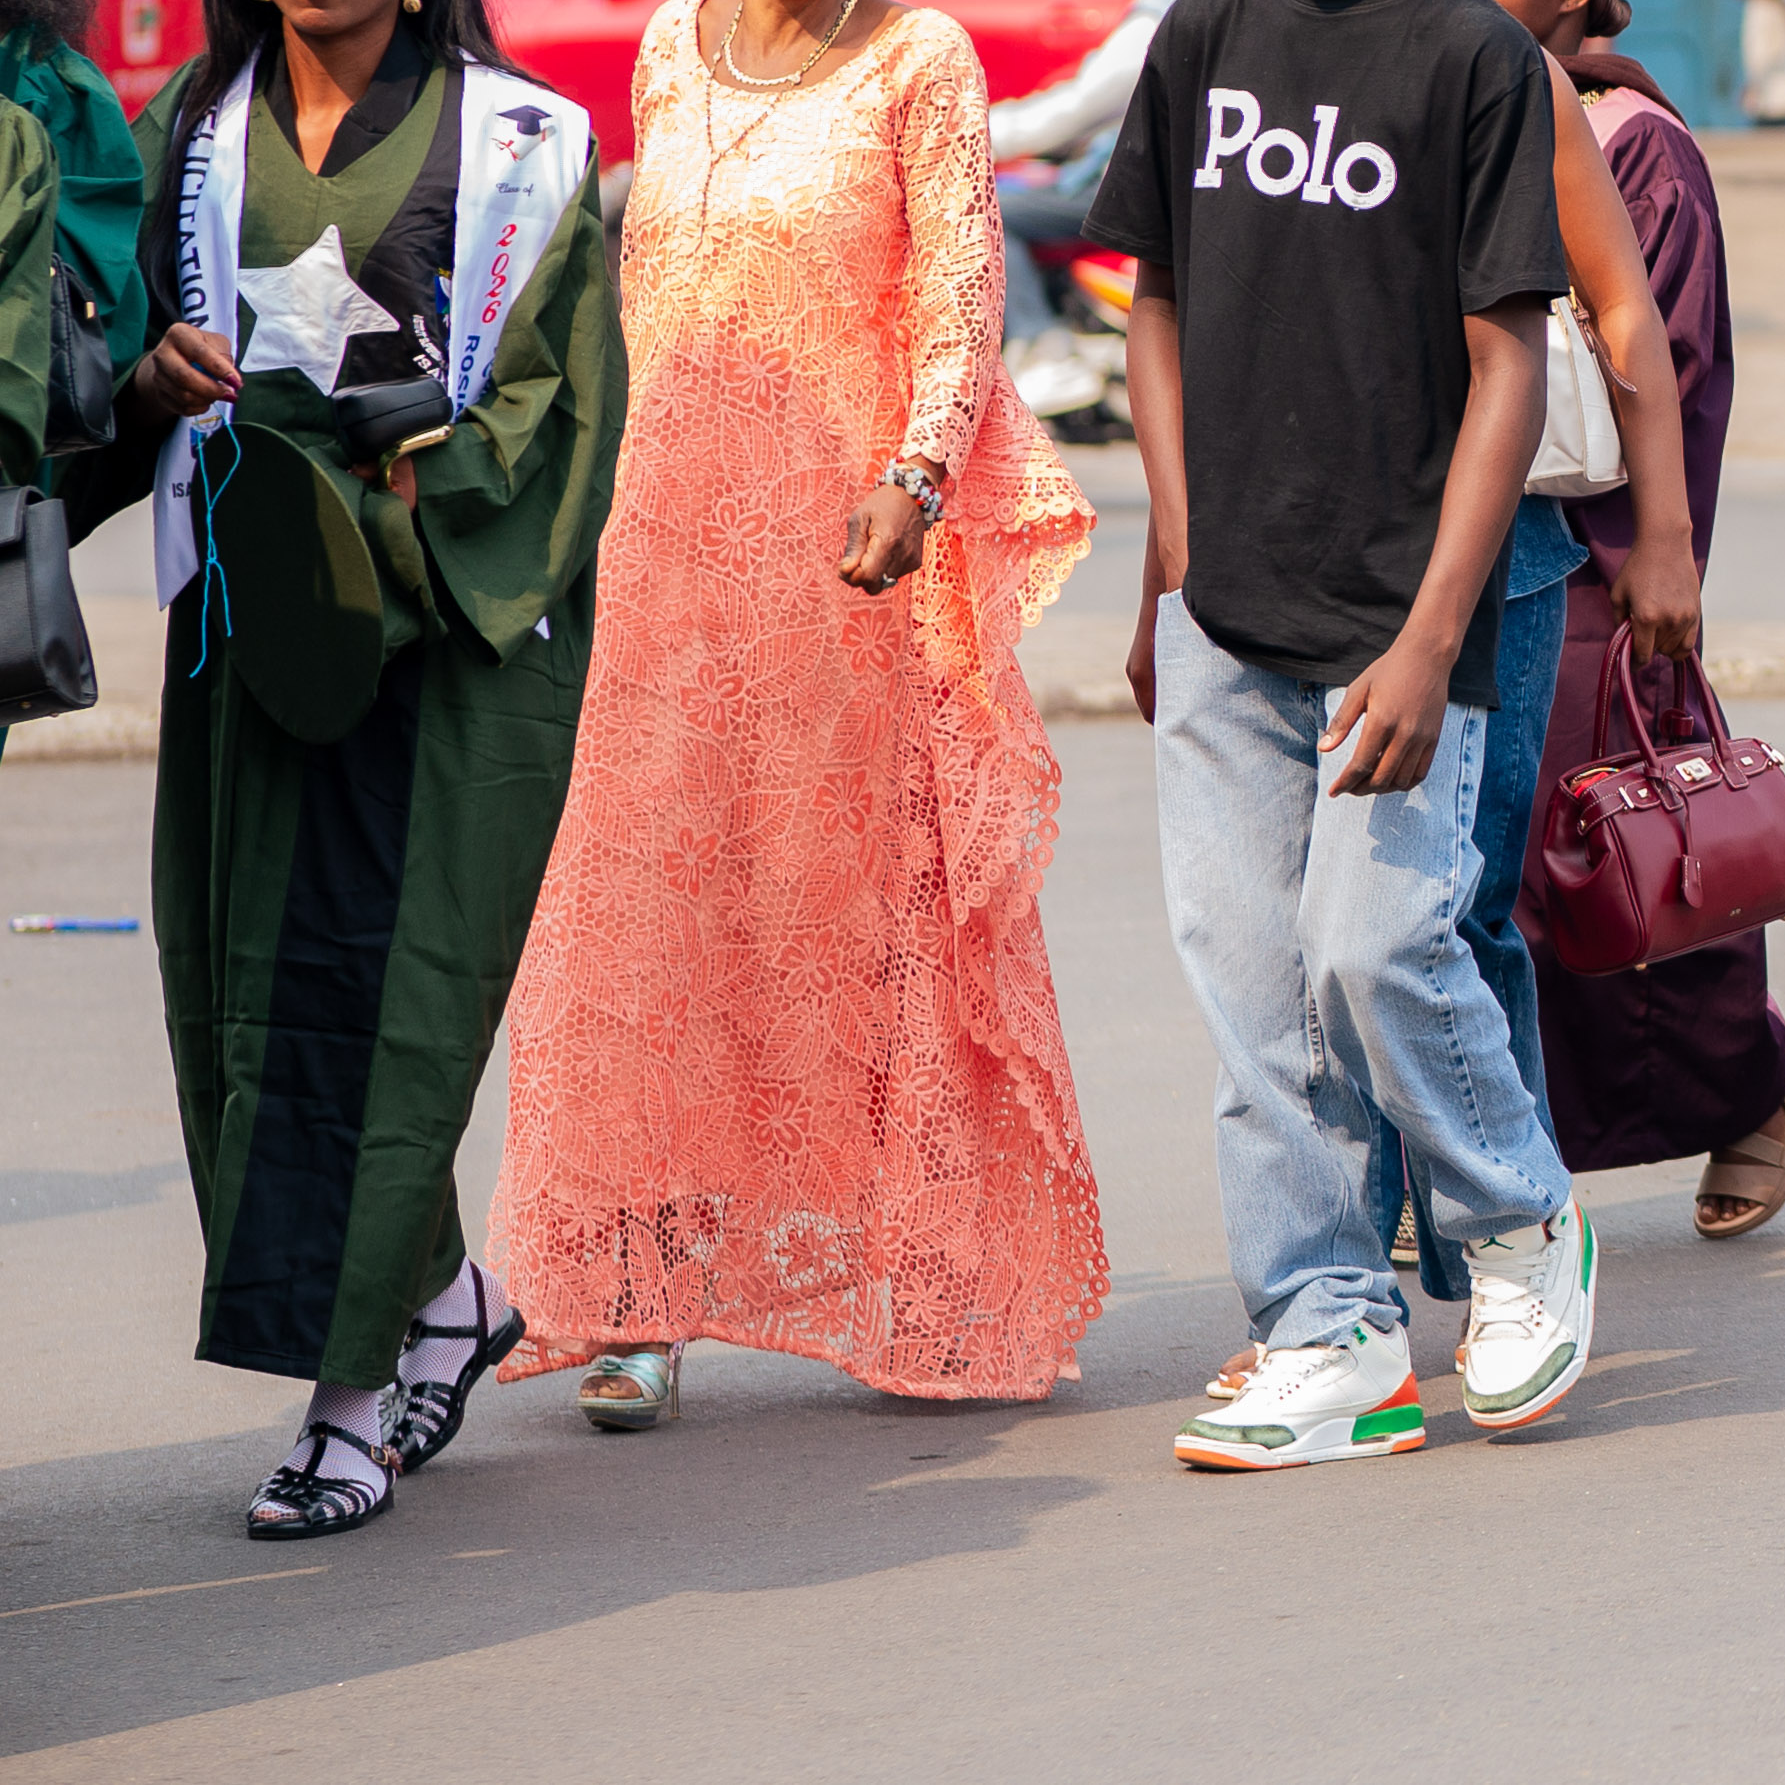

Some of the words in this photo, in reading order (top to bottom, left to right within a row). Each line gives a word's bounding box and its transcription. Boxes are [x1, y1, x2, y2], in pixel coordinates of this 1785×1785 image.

[1193, 87, 1398, 210] Polo
[496, 182, 520, 194] Class
[522, 183, 534, 197] of
